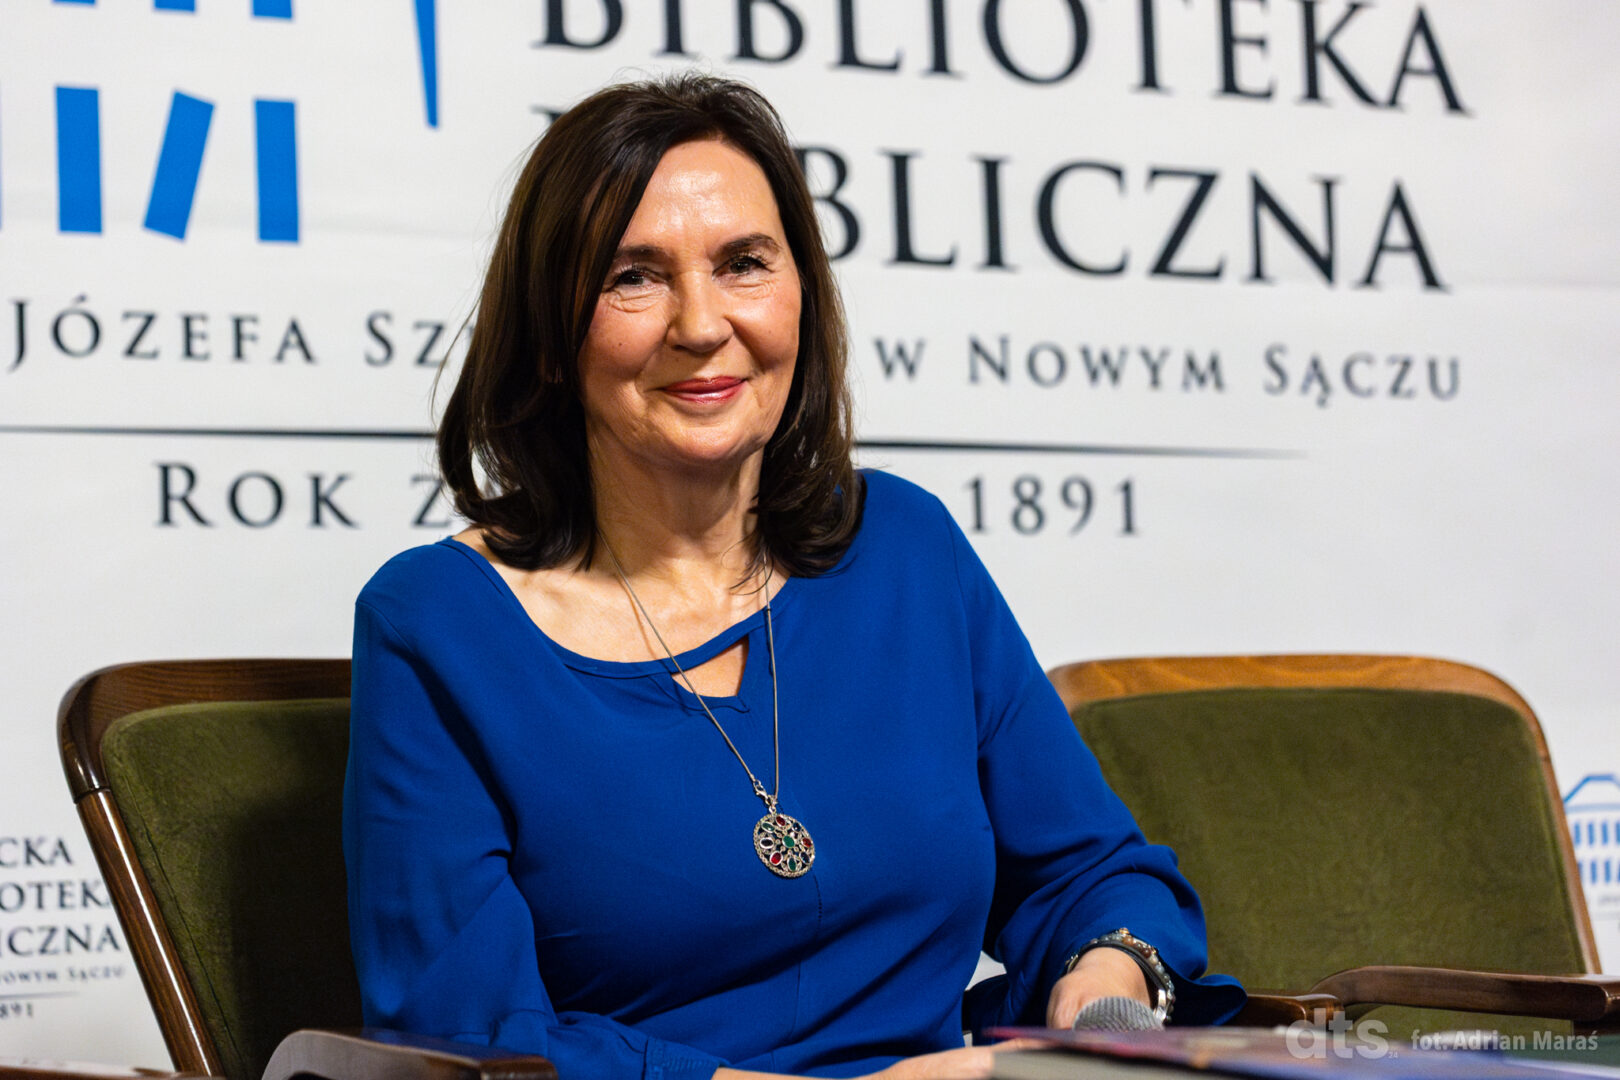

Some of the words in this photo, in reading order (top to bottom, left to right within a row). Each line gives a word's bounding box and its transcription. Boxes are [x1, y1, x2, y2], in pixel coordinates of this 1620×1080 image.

[531, 104, 1452, 294] BLICZNA
[8, 294, 318, 372] JÓZEFA
[967, 334, 1226, 393] NOWYM
[1263, 343, 1461, 408] SĄCZU
[154, 461, 361, 529] ROK
[963, 474, 1139, 535] 1891
[0, 880, 112, 913] OTEK
[0, 924, 122, 957] CZNA
